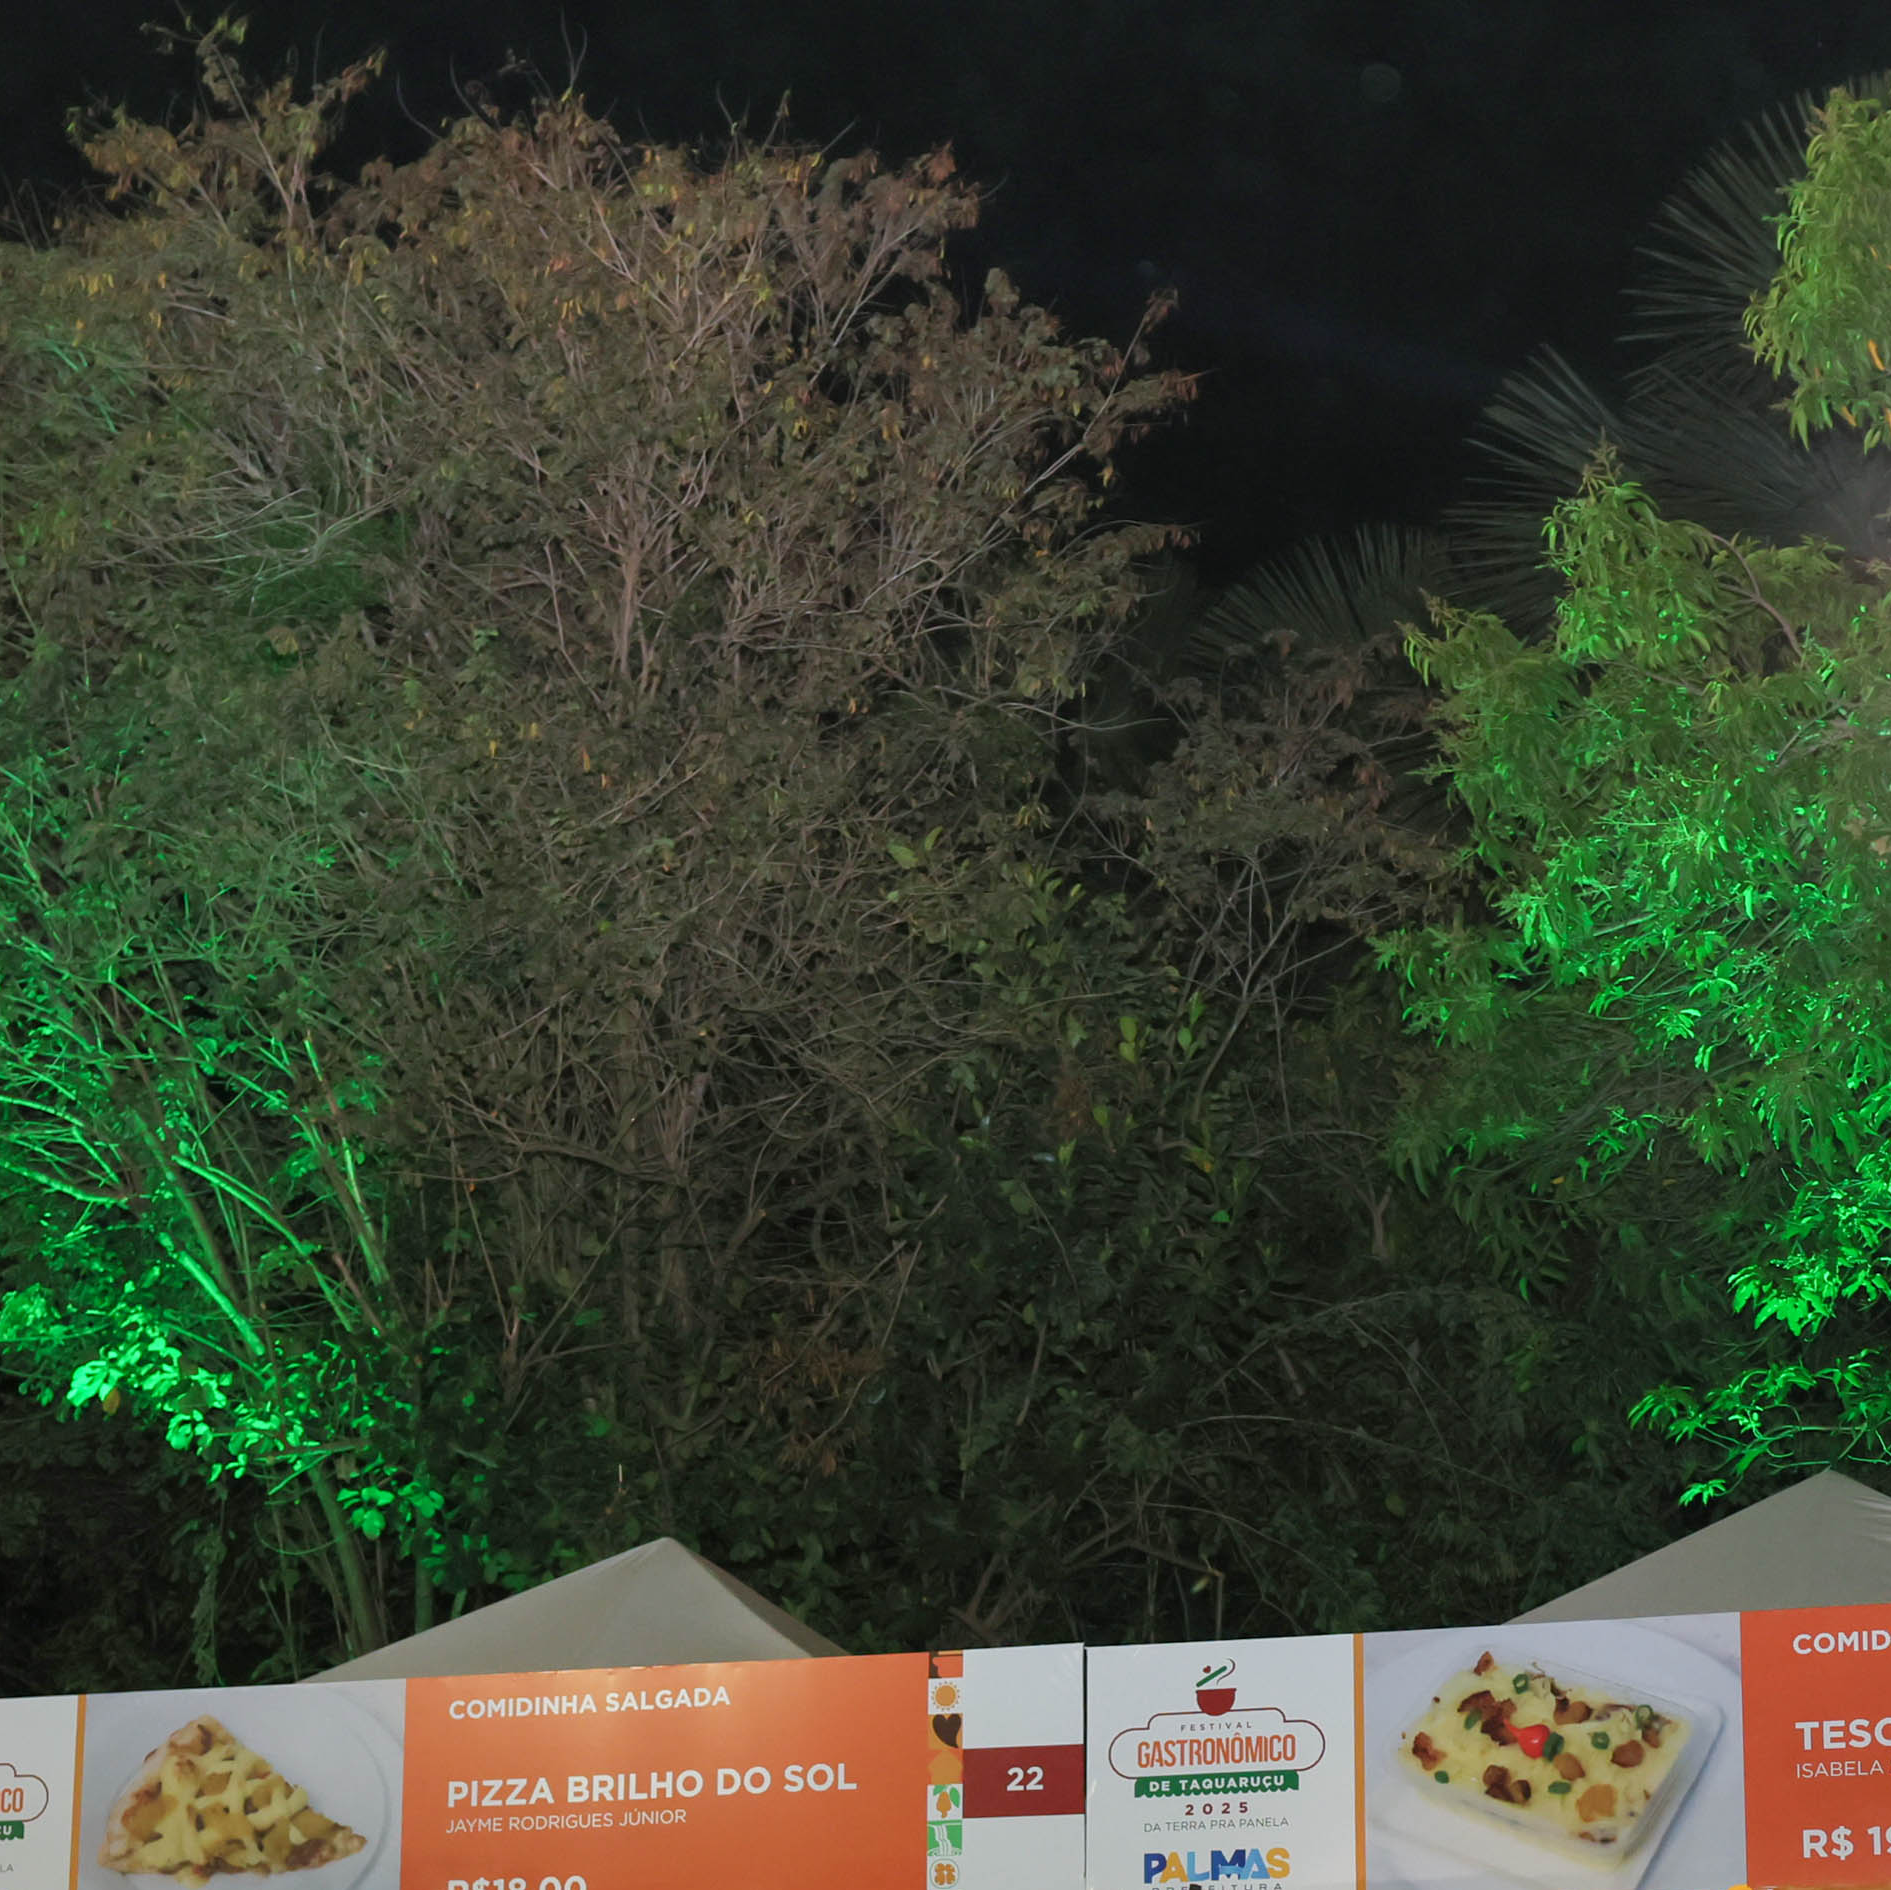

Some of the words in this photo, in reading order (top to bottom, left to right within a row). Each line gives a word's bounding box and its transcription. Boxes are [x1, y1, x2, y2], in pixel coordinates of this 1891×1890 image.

[448, 1693, 597, 1720] COMIDINHA
[605, 1686, 731, 1713] SALGADA
[1180, 1721, 1253, 1732] FESTIVAL
[1137, 1732, 1297, 1769] GASTRONÔMICO
[1006, 1766, 1044, 1791] 22
[1795, 1759, 1884, 1779] ISABELA
[447, 1776, 555, 1808] PIZZA
[566, 1769, 705, 1804] BRILHO
[716, 1766, 772, 1796] DO
[783, 1762, 858, 1793] SOL
[1148, 1780, 1171, 1793] DE
[1179, 1775, 1285, 1790] TAQUARUÇU
[445, 1816, 503, 1834] JAYME
[508, 1812, 614, 1831] RODRIGUES
[618, 1808, 687, 1827] JÚNIOR
[1185, 1801, 1249, 1816] 2025
[1144, 1822, 1161, 1833] DA
[1165, 1820, 1208, 1832] TERRA
[1210, 1818, 1236, 1830] PRA
[1239, 1816, 1290, 1828] PANELA
[1802, 1825, 1854, 1861] R$
[1144, 1847, 1291, 1884] PALMAS
